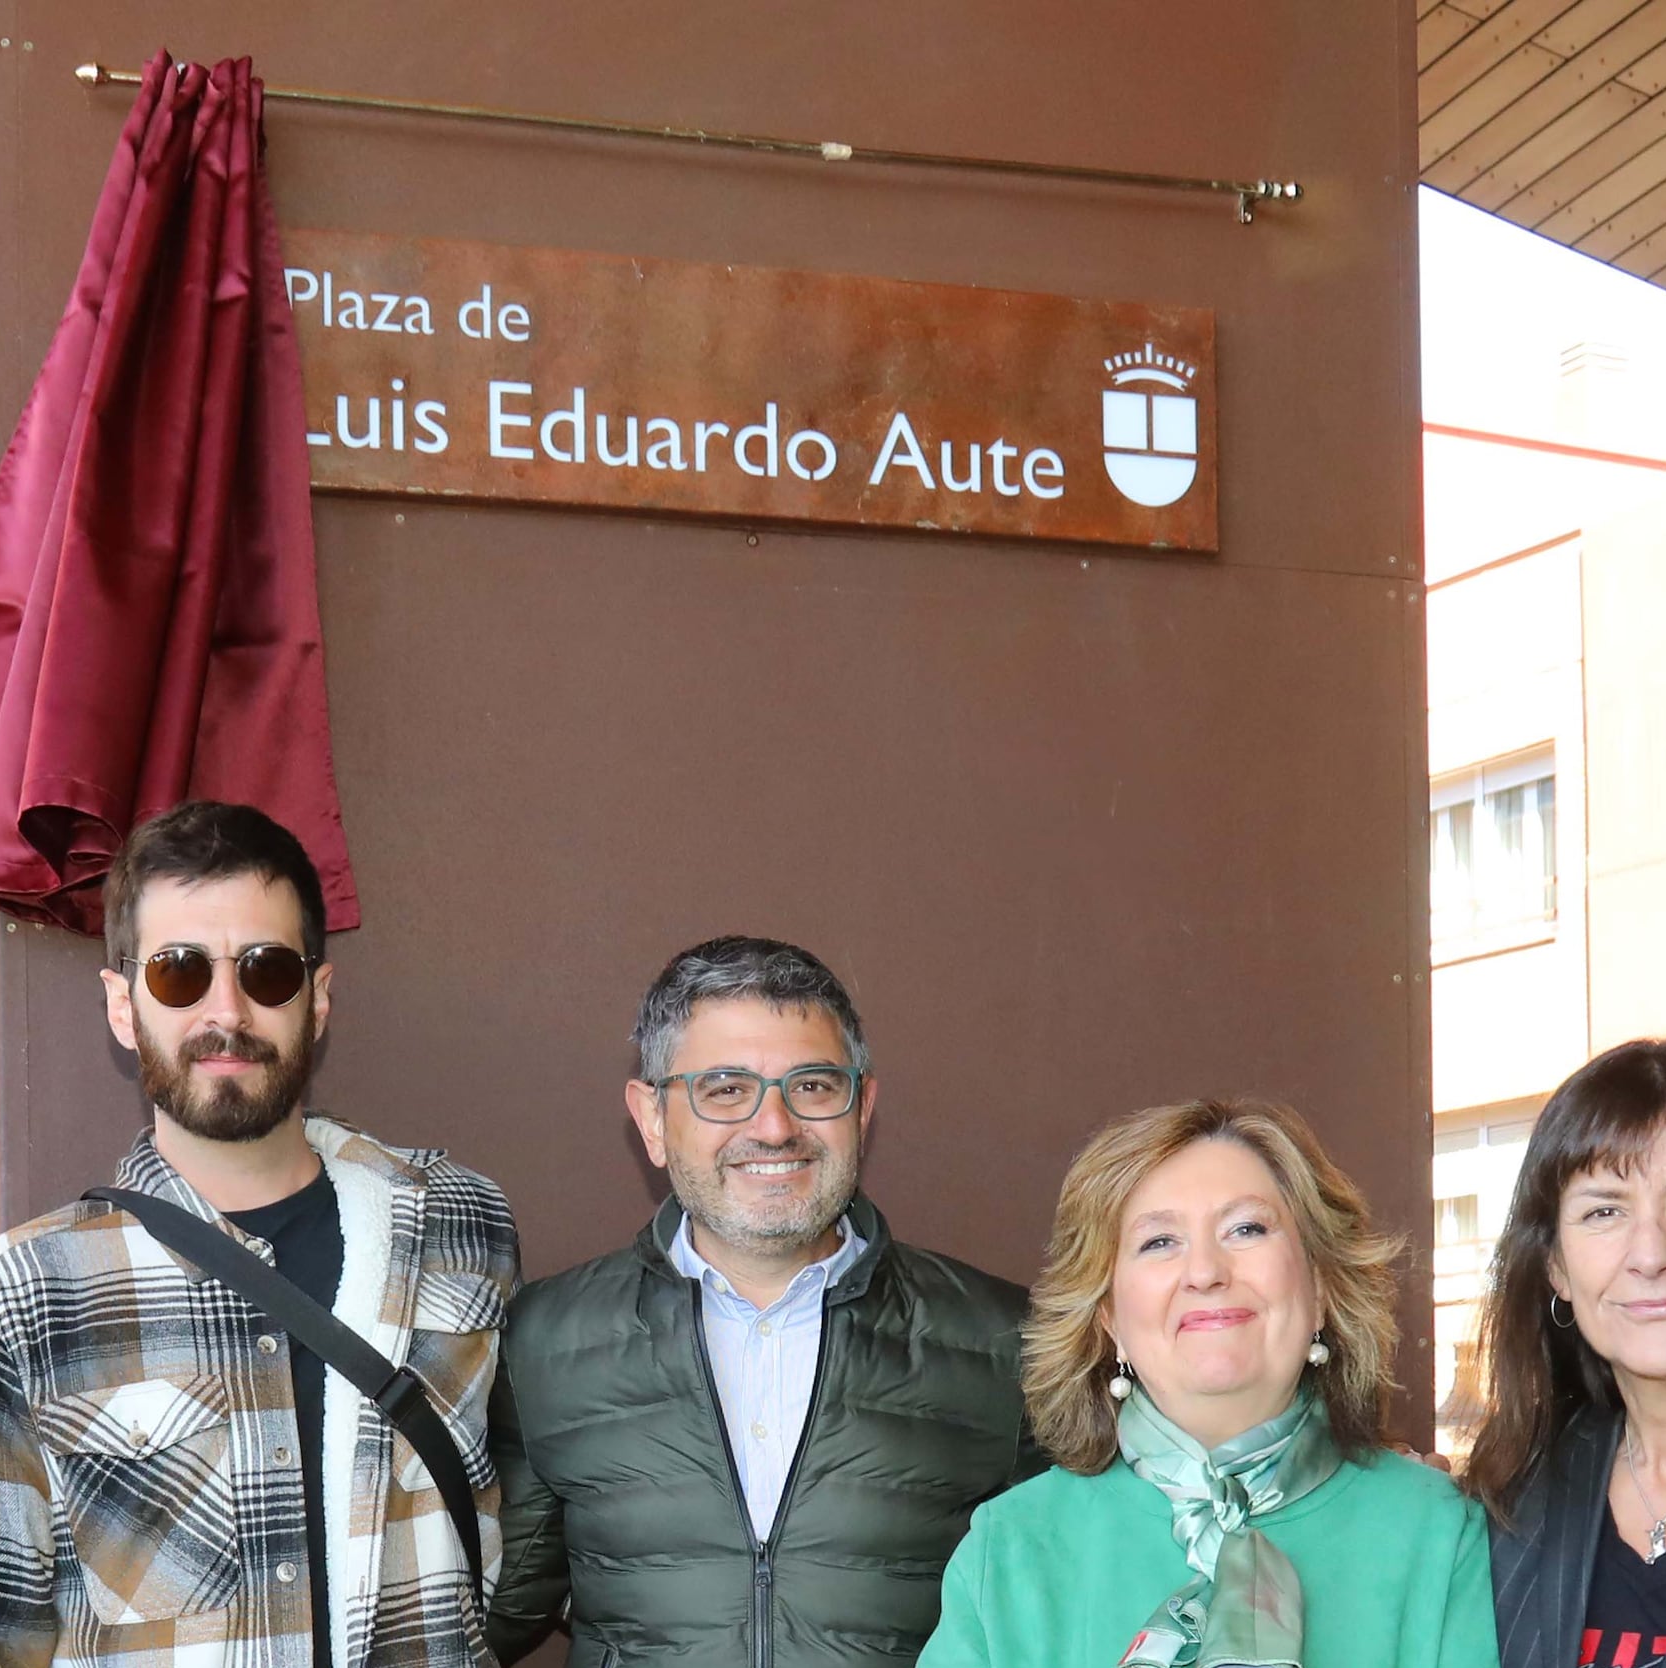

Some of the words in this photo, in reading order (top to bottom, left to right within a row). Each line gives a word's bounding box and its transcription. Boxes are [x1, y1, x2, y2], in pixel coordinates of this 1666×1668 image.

[284, 268, 434, 335] Plaza
[458, 283, 530, 342] de
[306, 378, 449, 454] uis
[488, 380, 838, 482] Eduardo
[869, 411, 1066, 499] Aute
